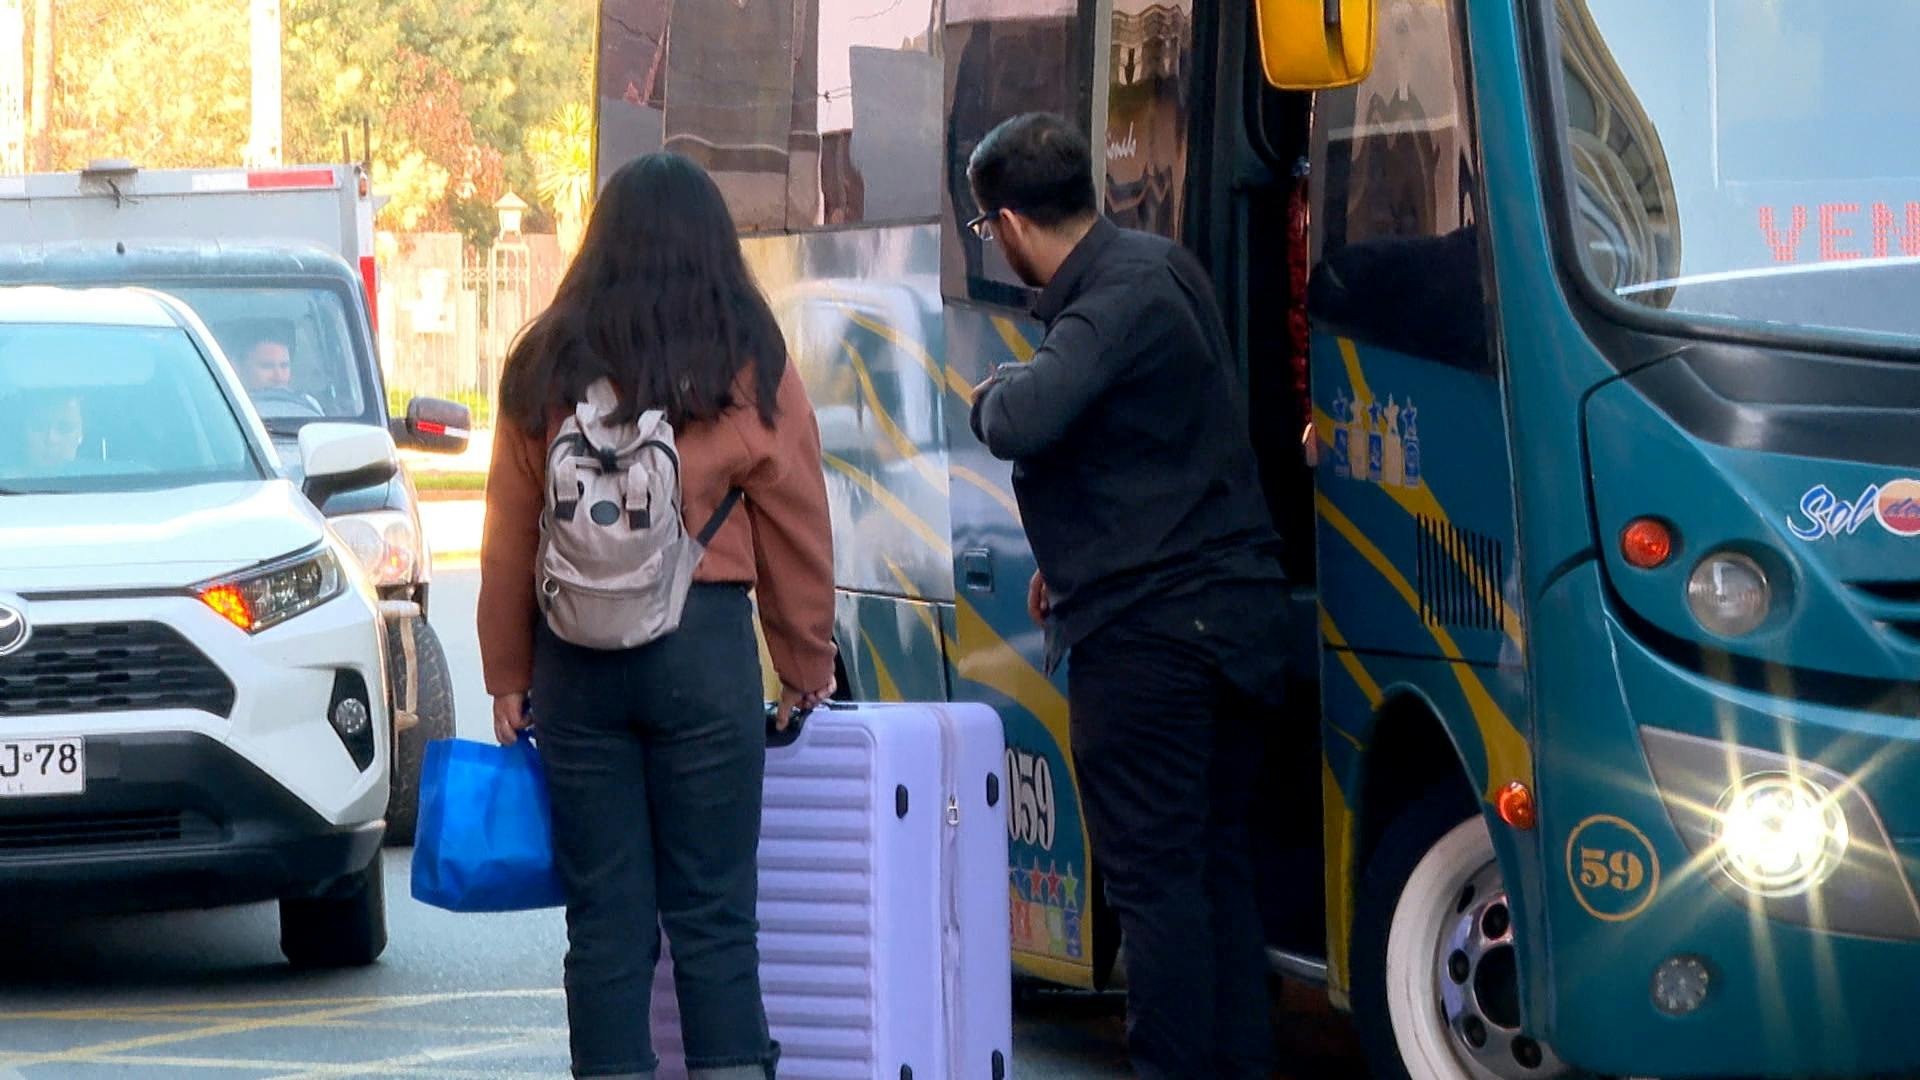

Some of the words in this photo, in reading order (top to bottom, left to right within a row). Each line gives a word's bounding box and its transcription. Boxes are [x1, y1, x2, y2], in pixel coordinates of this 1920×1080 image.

[1758, 202, 1920, 261] VEN
[1787, 483, 1879, 540] Sol
[1580, 847, 1644, 892] 59
